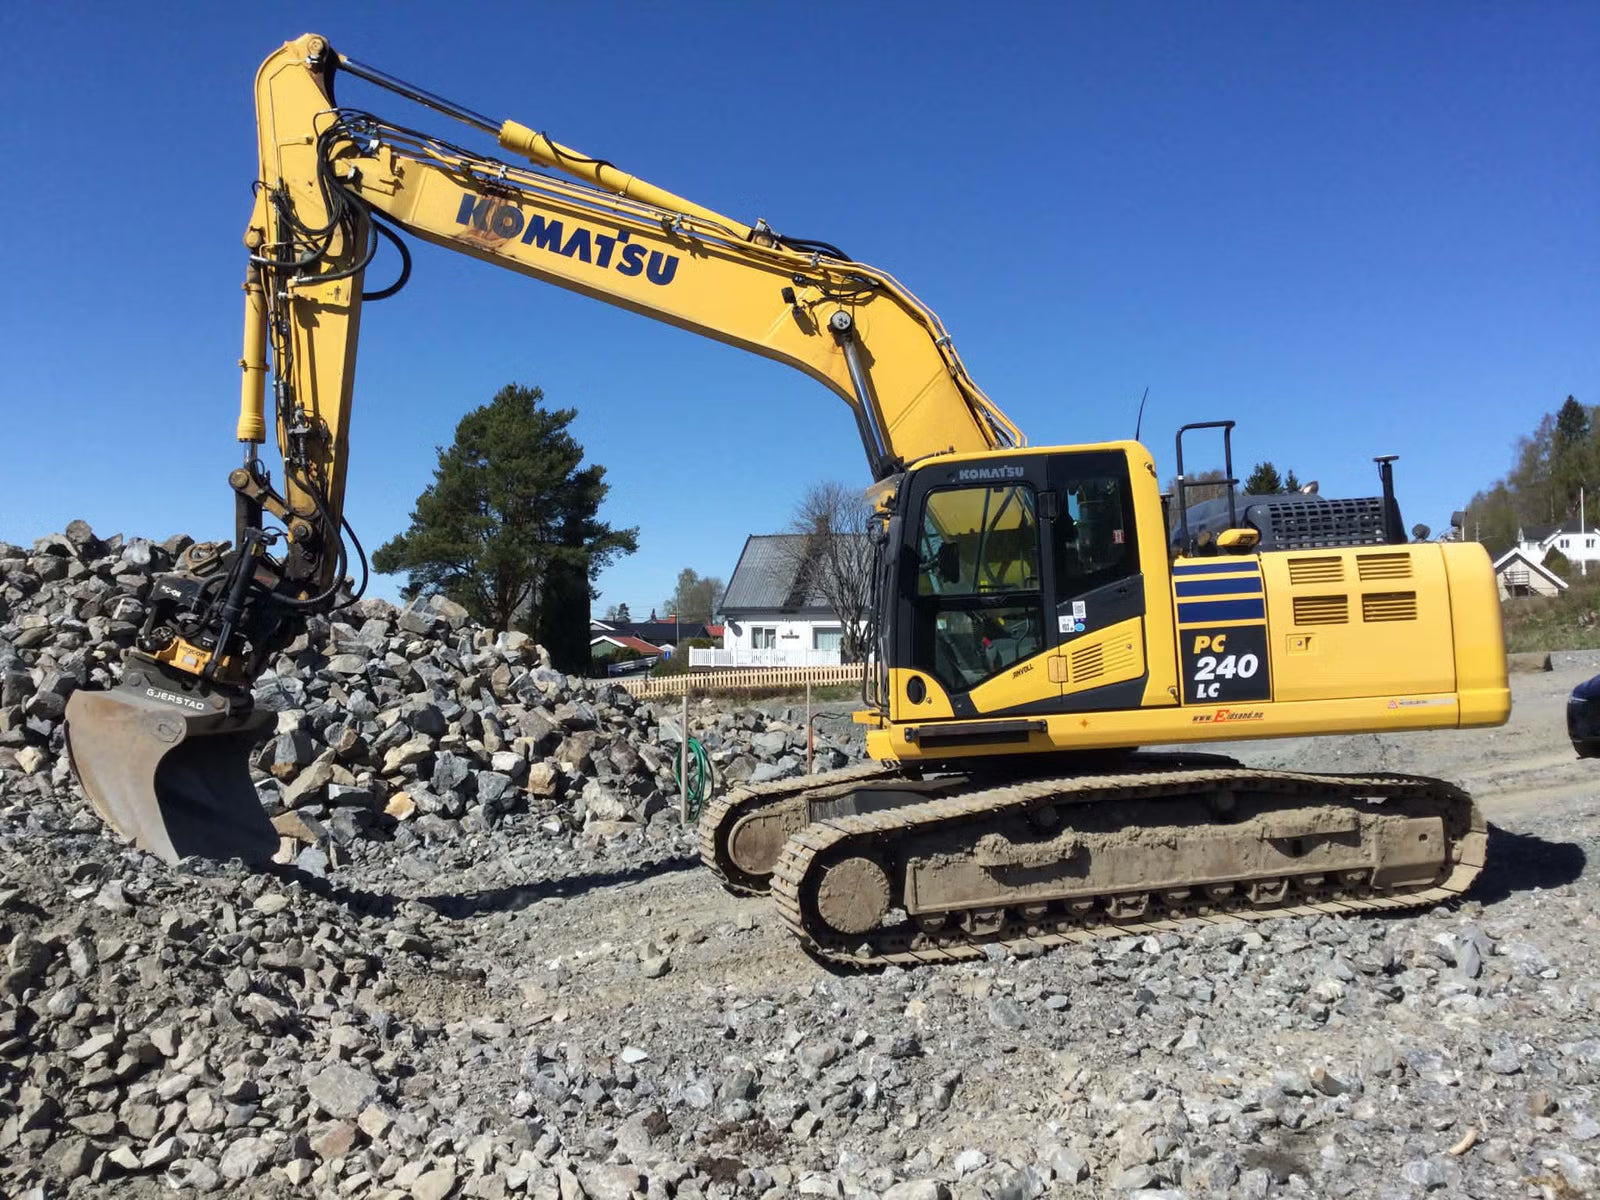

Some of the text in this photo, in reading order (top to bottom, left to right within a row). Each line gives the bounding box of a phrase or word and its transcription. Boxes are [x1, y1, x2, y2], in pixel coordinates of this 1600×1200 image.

[456, 192, 679, 286] KOMATSU
[959, 465, 1024, 480] KOMATSU
[1193, 634, 1226, 654] PC
[1194, 653, 1259, 681] 240
[146, 688, 204, 710] GJERSTAD
[1196, 682, 1221, 699] LC
